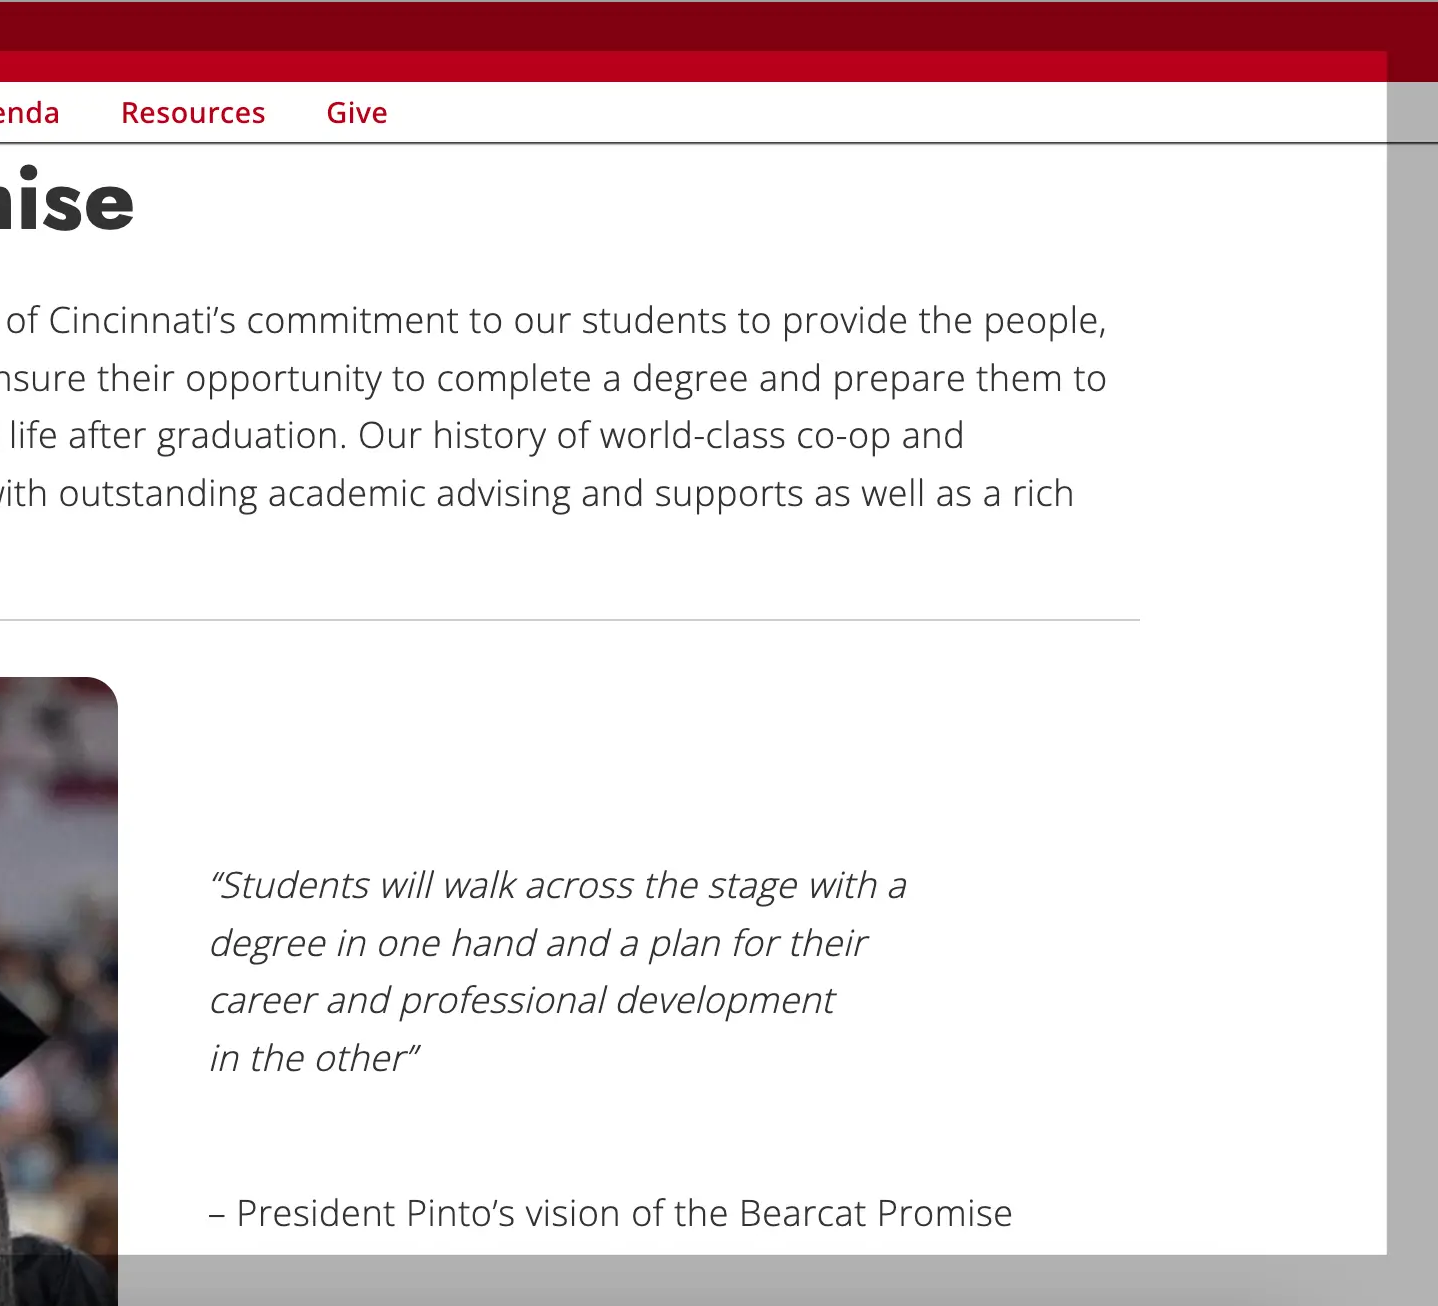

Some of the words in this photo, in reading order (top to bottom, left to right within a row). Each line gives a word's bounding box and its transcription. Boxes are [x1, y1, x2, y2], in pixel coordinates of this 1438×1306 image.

[122, 101, 266, 125] Resources
[327, 100, 388, 125] Give
[6, 304, 41, 335] of
[49, 305, 236, 335] Cincinnati’s
[247, 305, 459, 335] commitment
[468, 308, 502, 335] to
[514, 312, 572, 335] our
[582, 304, 727, 335] students
[737, 308, 771, 335] to
[784, 304, 907, 343] provide
[918, 304, 972, 335] the
[985, 304, 1105, 343] people,
[96, 362, 175, 393] their
[186, 363, 383, 401] opportunity
[391, 366, 425, 393] to
[437, 362, 591, 401] complete
[603, 370, 620, 393] a
[633, 362, 748, 401] degree
[759, 362, 820, 393] and
[834, 370, 965, 401] prepare
[975, 362, 1061, 393] them
[1073, 366, 1106, 393] to
[11, 419, 57, 450] life
[69, 419, 147, 450] after
[156, 419, 346, 458] graduation.
[359, 420, 423, 450] Our
[434, 419, 547, 458] history
[557, 419, 592, 450] of
[599, 419, 785, 450] world-class
[797, 427, 891, 458] co-op
[902, 419, 963, 450] and
[59, 477, 258, 516] outstanding
[268, 477, 426, 508] academic
[437, 477, 571, 516] advising
[582, 477, 643, 508] and
[655, 481, 804, 516] supports
[815, 485, 851, 508] as
[861, 477, 923, 508] well
[936, 485, 972, 508] as
[983, 485, 1000, 508] a
[1014, 477, 1073, 507] rich
[211, 869, 371, 900] “Students
[382, 869, 435, 899] will
[445, 869, 518, 900] walk
[525, 877, 636, 900] across
[645, 869, 699, 900] the
[708, 873, 798, 908] stage
[810, 869, 878, 900] with
[888, 877, 907, 900] a
[210, 927, 327, 966] degree
[337, 928, 367, 957] in
[378, 935, 441, 957] one
[451, 927, 539, 958] hand
[546, 927, 612, 958] and
[619, 935, 639, 958] a
[648, 927, 721, 966] plan
[733, 927, 782, 958] for
[790, 927, 871, 958] their
[210, 992, 320, 1015] career
[326, 984, 393, 1015] and
[398, 984, 609, 1023] professional
[617, 984, 838, 1023] development
[210, 1043, 240, 1072] in
[251, 1042, 305, 1073] the
[316, 1042, 422, 1073] other”
[238, 1197, 396, 1228] President
[408, 1198, 515, 1228] Pinto’s
[525, 1198, 619, 1228] vision
[632, 1197, 667, 1228] of
[673, 1197, 728, 1228] the
[741, 1199, 867, 1228] Bearcat
[879, 1198, 1012, 1228] Promise
